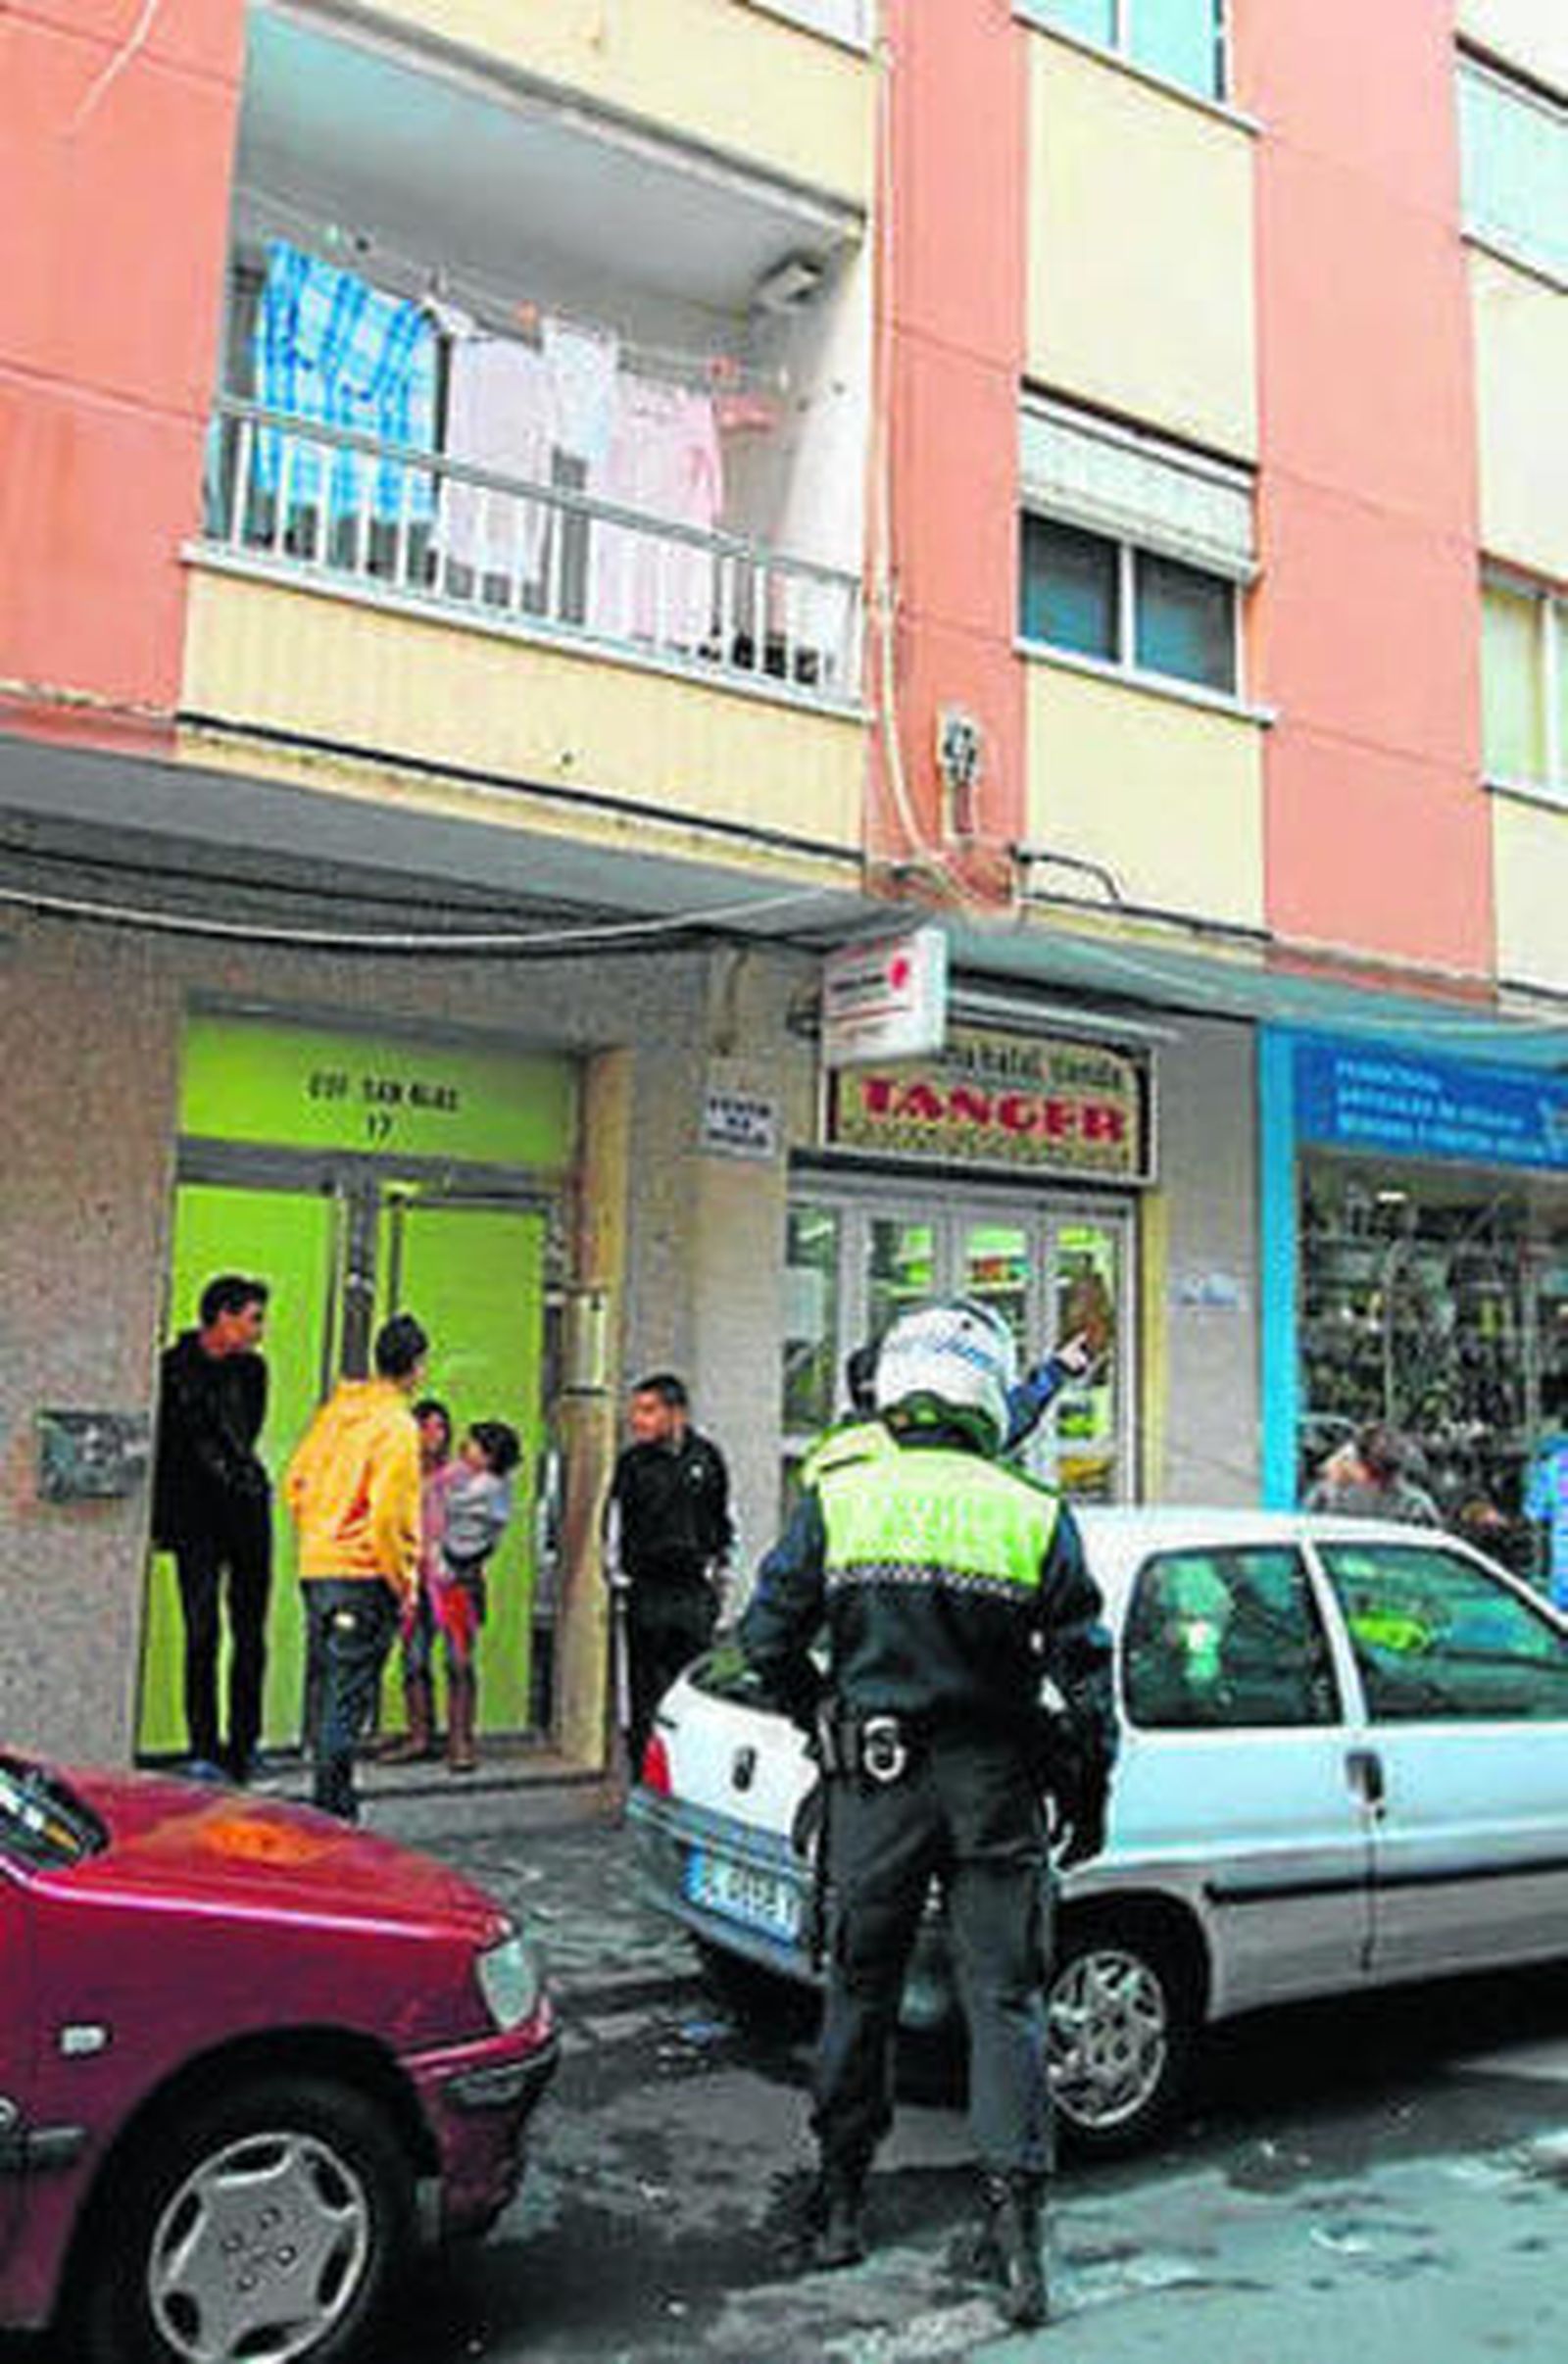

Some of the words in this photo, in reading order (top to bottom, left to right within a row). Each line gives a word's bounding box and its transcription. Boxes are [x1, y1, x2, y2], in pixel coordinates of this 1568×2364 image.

[363, 1075, 403, 1105] SAN
[861, 1077, 1127, 1143] TANGER
[367, 1111, 393, 1140] 17
